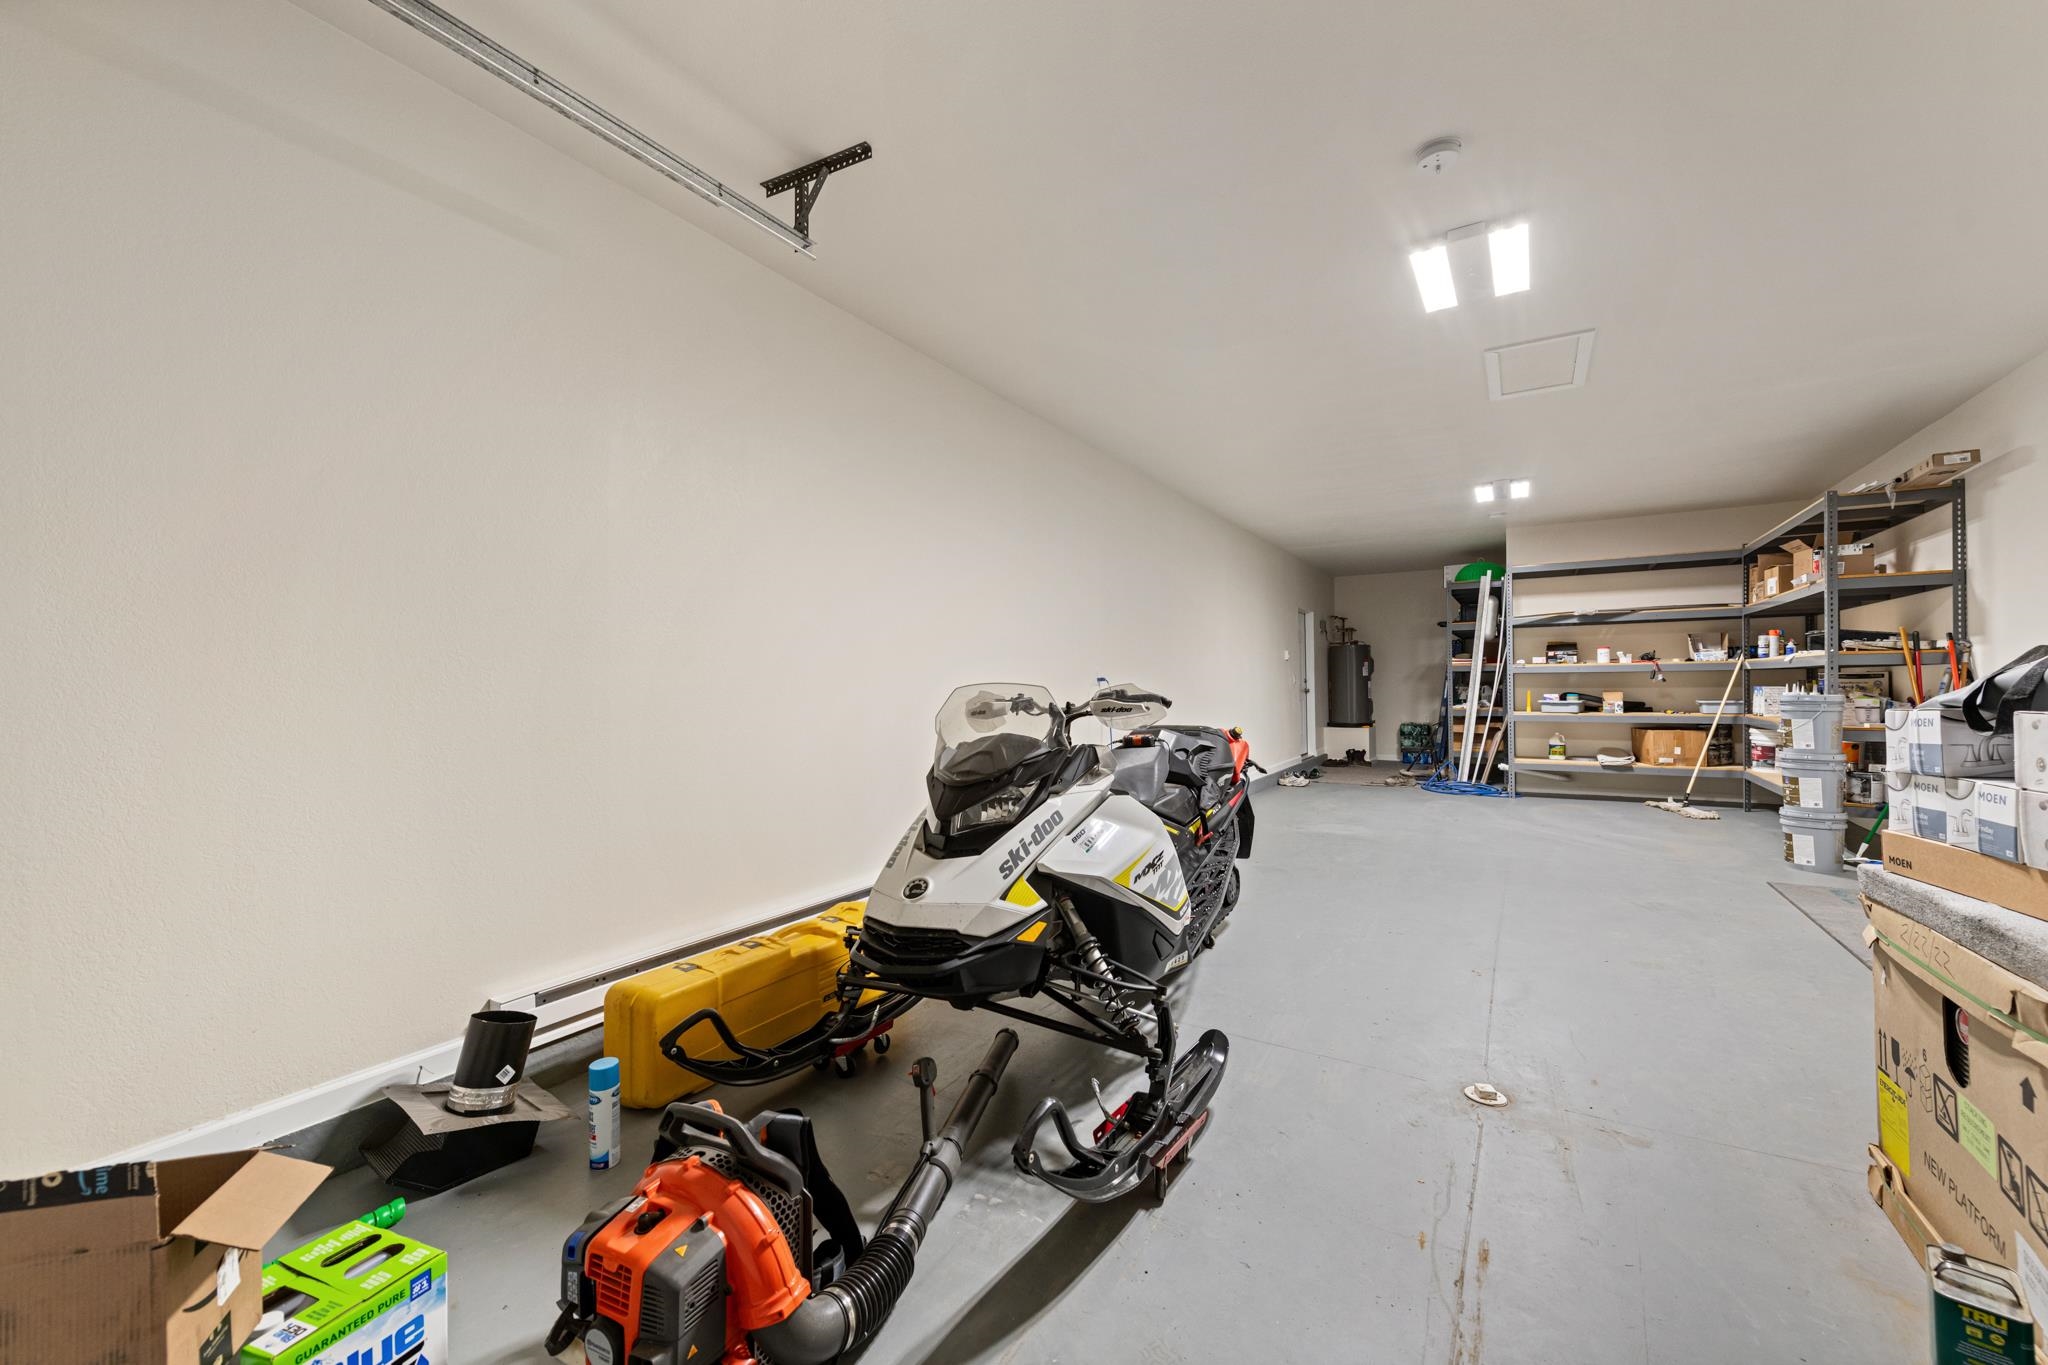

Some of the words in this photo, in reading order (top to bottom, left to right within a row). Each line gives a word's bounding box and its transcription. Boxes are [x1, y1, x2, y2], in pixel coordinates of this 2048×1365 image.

[1910, 717, 1934, 728] MOEN
[1914, 782, 1939, 794] MOEN
[1978, 791, 2007, 806] MOEN
[999, 809, 1064, 880] ski-doo
[1888, 855, 1913, 870] MOEN
[1923, 1151, 1947, 1187] NEW
[1948, 1177, 2007, 1260] PLATFORM
[295, 1310, 375, 1365] GUARANTEED
[377, 1288, 406, 1314] PURE
[1957, 1303, 2009, 1332] TRU
